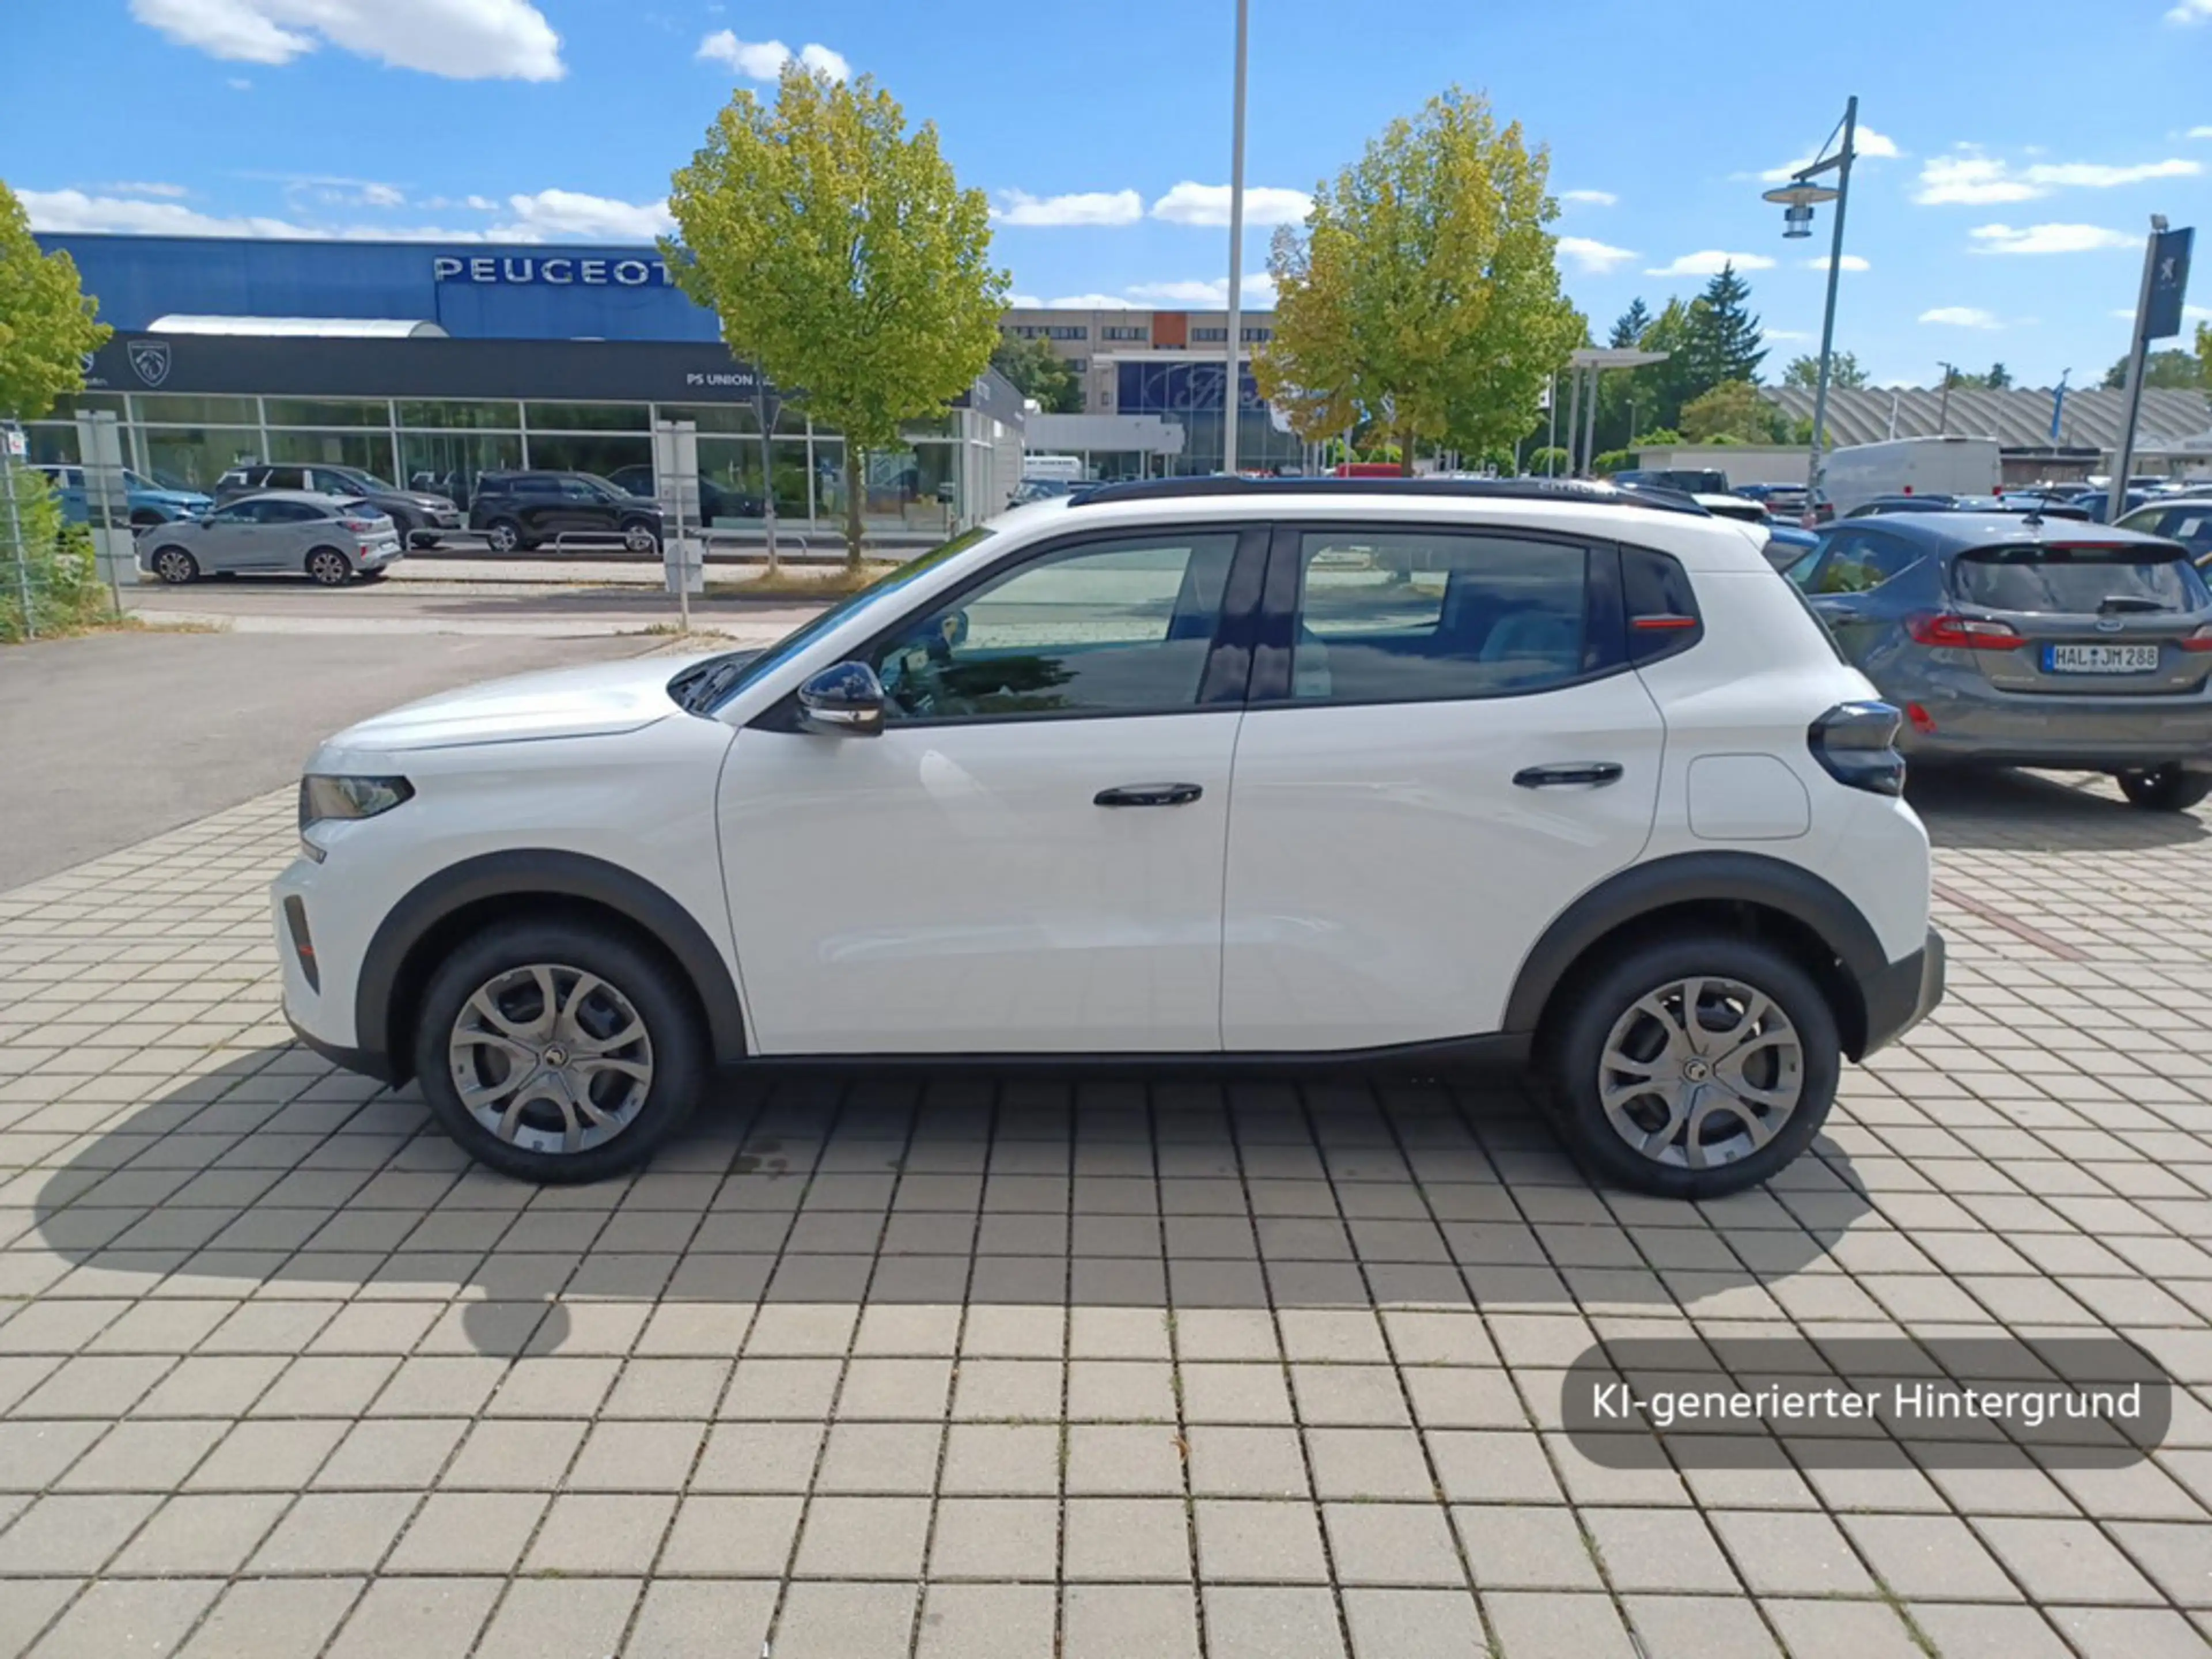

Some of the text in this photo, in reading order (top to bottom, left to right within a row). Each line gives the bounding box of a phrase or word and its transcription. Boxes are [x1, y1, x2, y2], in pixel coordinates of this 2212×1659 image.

[687, 374, 704, 385] PS
[706, 374, 753, 385] UNION
[2057, 647, 2087, 665] HAL
[2126, 647, 2155, 666] 288
